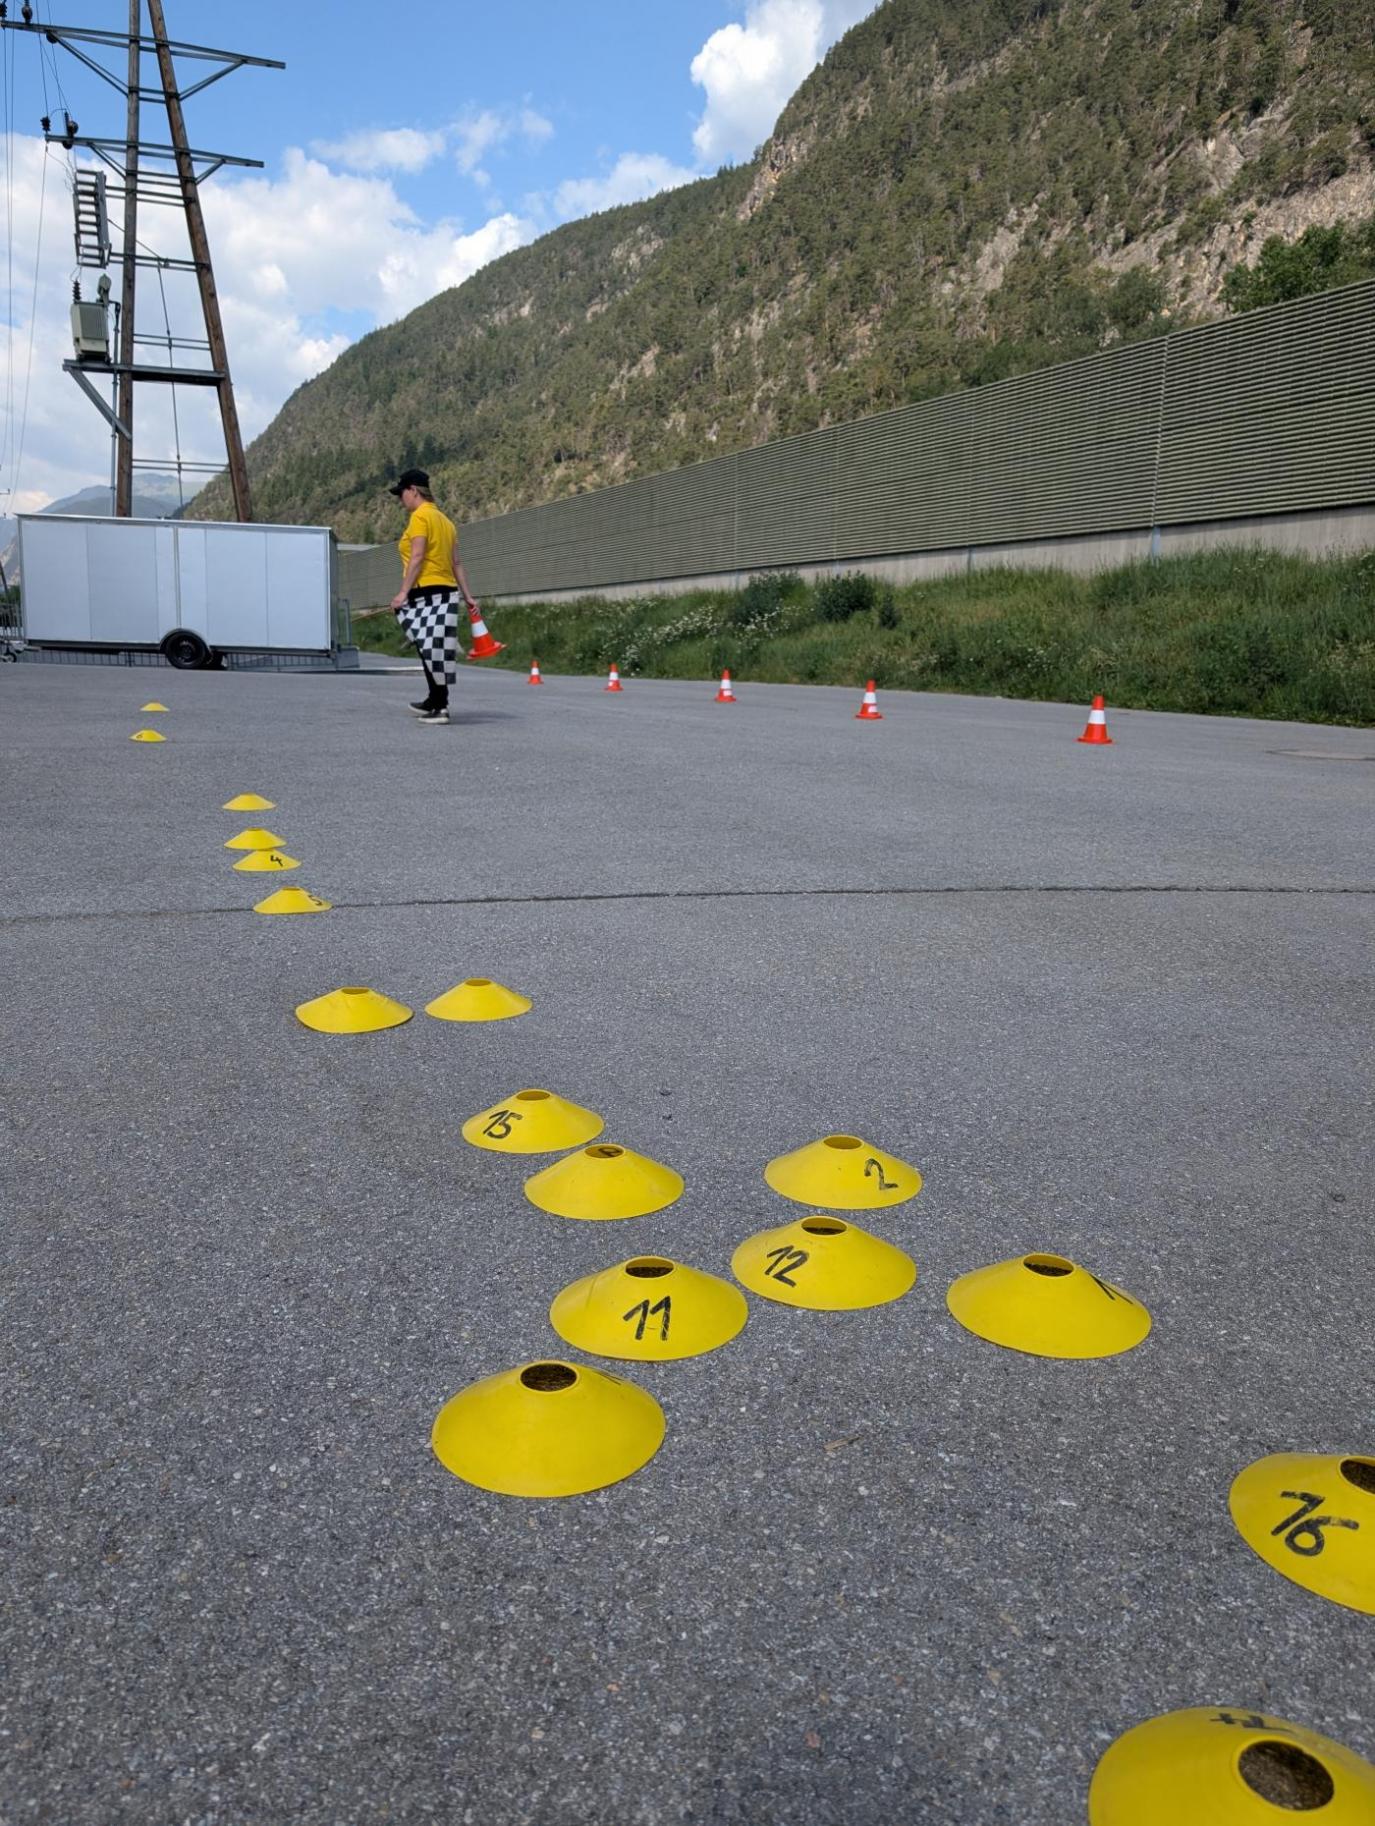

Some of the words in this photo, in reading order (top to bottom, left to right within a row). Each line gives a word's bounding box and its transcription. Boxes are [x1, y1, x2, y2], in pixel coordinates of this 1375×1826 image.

[482, 1109, 524, 1139] 15
[864, 1158, 899, 1191] 2
[764, 1245, 810, 1288] 12
[622, 1295, 671, 1341] 11
[1270, 1490, 1360, 1557] 16
